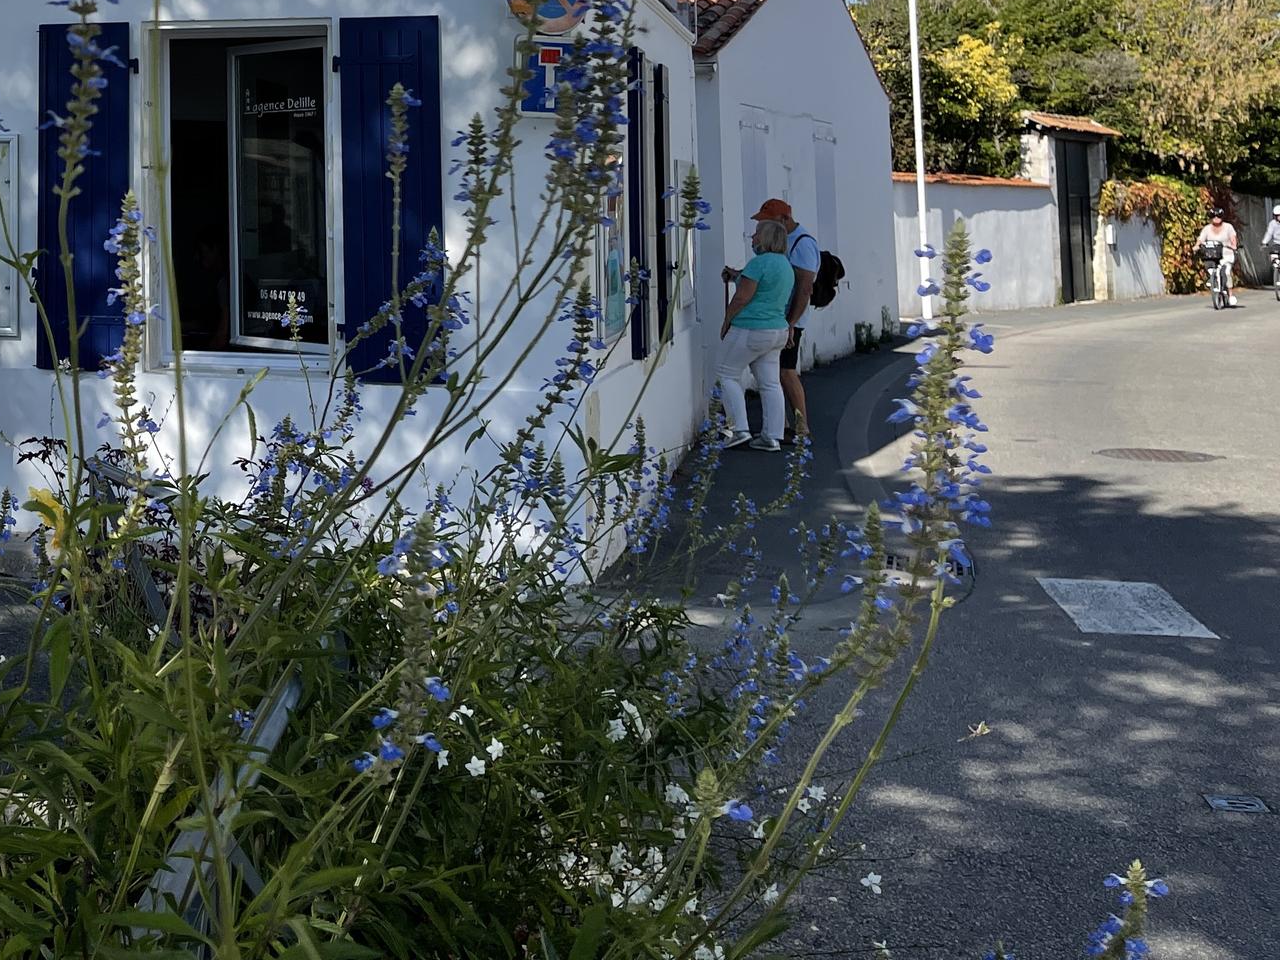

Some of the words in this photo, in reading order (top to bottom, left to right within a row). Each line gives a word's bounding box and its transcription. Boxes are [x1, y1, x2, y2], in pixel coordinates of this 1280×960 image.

[260, 289, 268, 300] 05
[269, 289, 278, 301] 46
[278, 290, 287, 301] 47
[297, 291, 306, 302] 49
